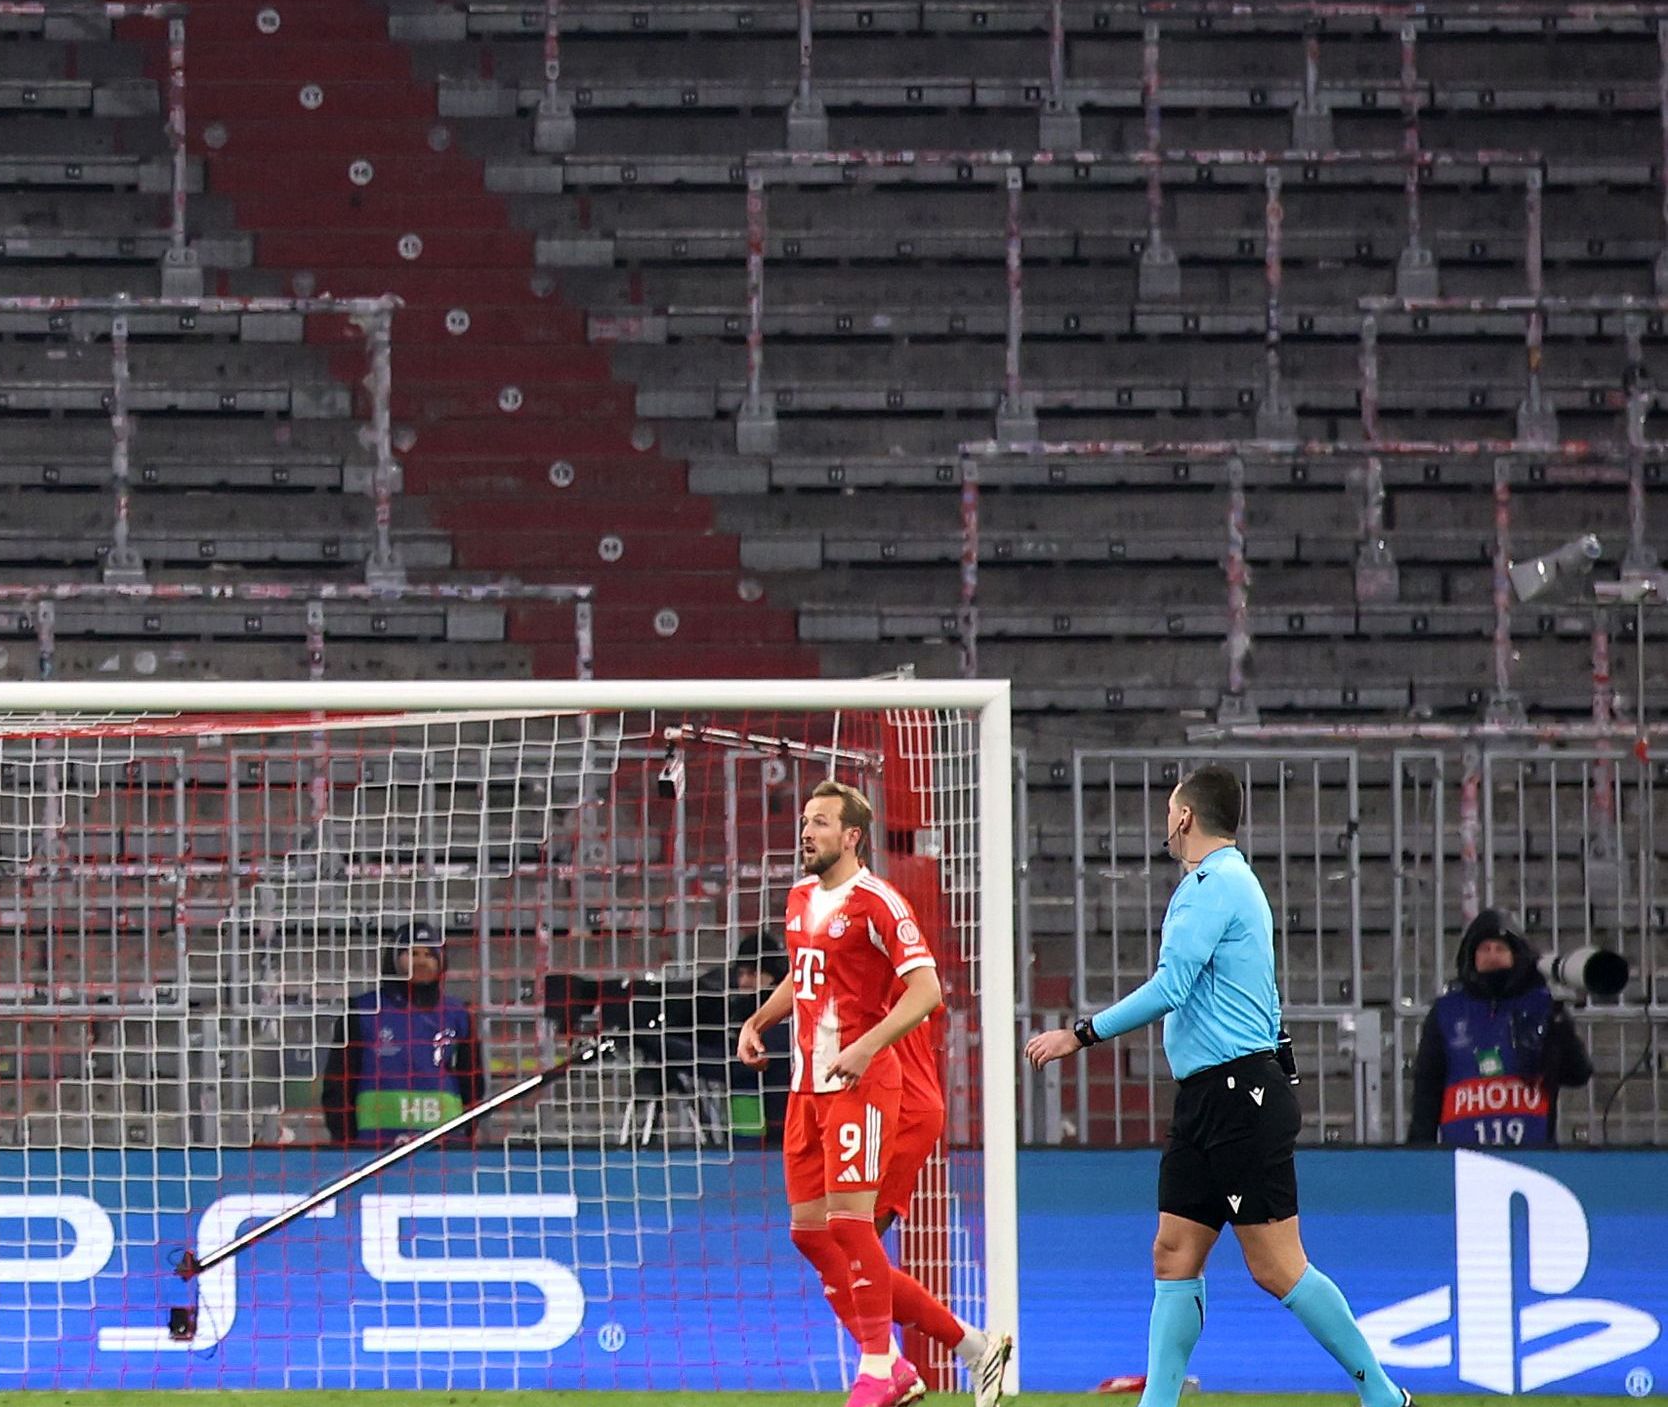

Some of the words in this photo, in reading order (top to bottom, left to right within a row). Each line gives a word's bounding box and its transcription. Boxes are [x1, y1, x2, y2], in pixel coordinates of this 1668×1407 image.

[399, 1097, 442, 1123] HB
[839, 1122, 862, 1163] 9
[1474, 1117, 1525, 1145] 119
